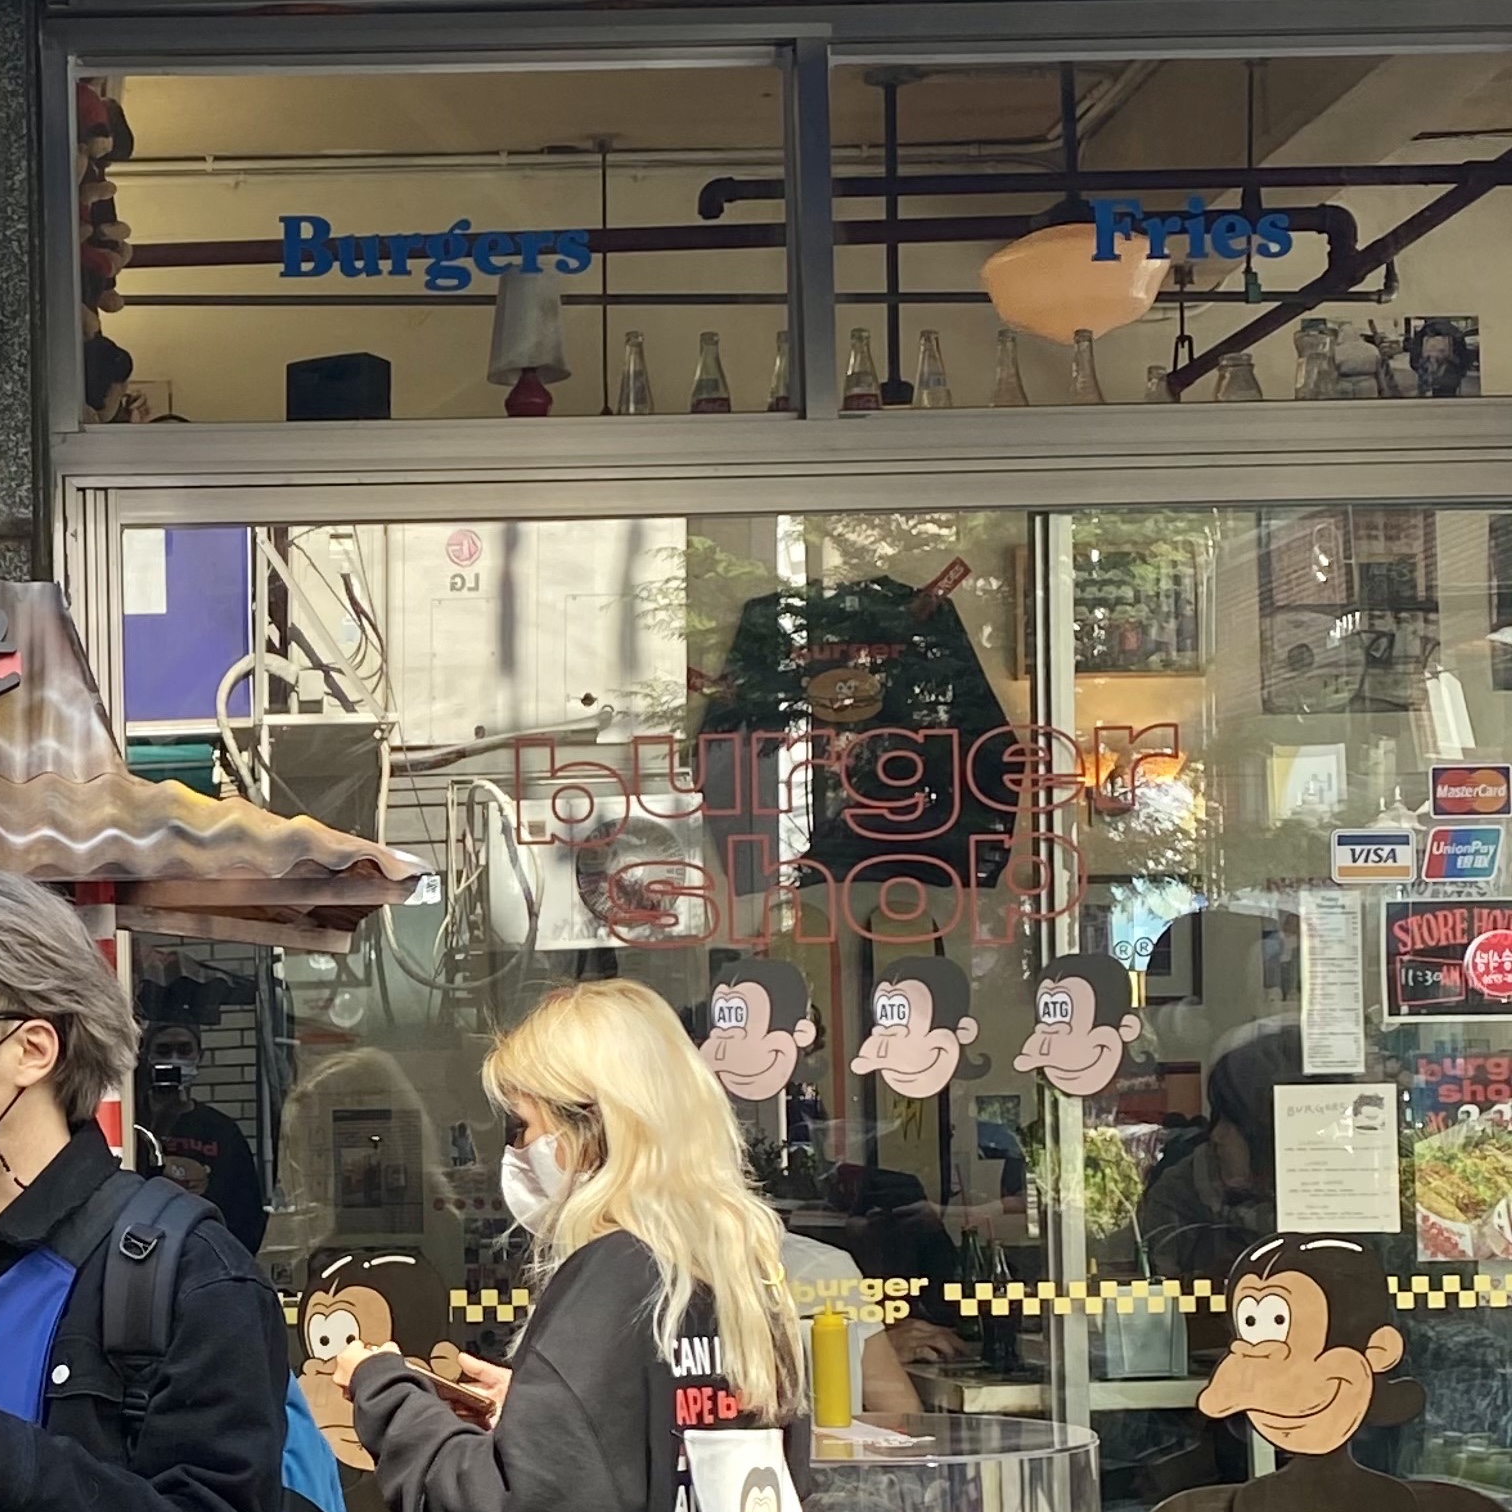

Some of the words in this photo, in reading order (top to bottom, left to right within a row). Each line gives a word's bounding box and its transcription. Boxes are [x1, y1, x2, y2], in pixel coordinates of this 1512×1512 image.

[1089, 197, 1294, 262] Fries
[279, 214, 593, 291] Burgers
[515, 721, 1179, 846] burger
[1436, 784, 1507, 798] MasterCard
[1349, 847, 1398, 863] VISA
[1431, 840, 1496, 859] UnionPay
[608, 831, 1087, 948] shop
[1393, 909, 1468, 953] STORE
[717, 1004, 744, 1025] ATG
[878, 1002, 907, 1023] ATG
[1041, 1001, 1070, 1021] ATG
[792, 1277, 929, 1303] burger
[671, 1336, 711, 1378] CAN
[676, 1387, 716, 1426] APE
